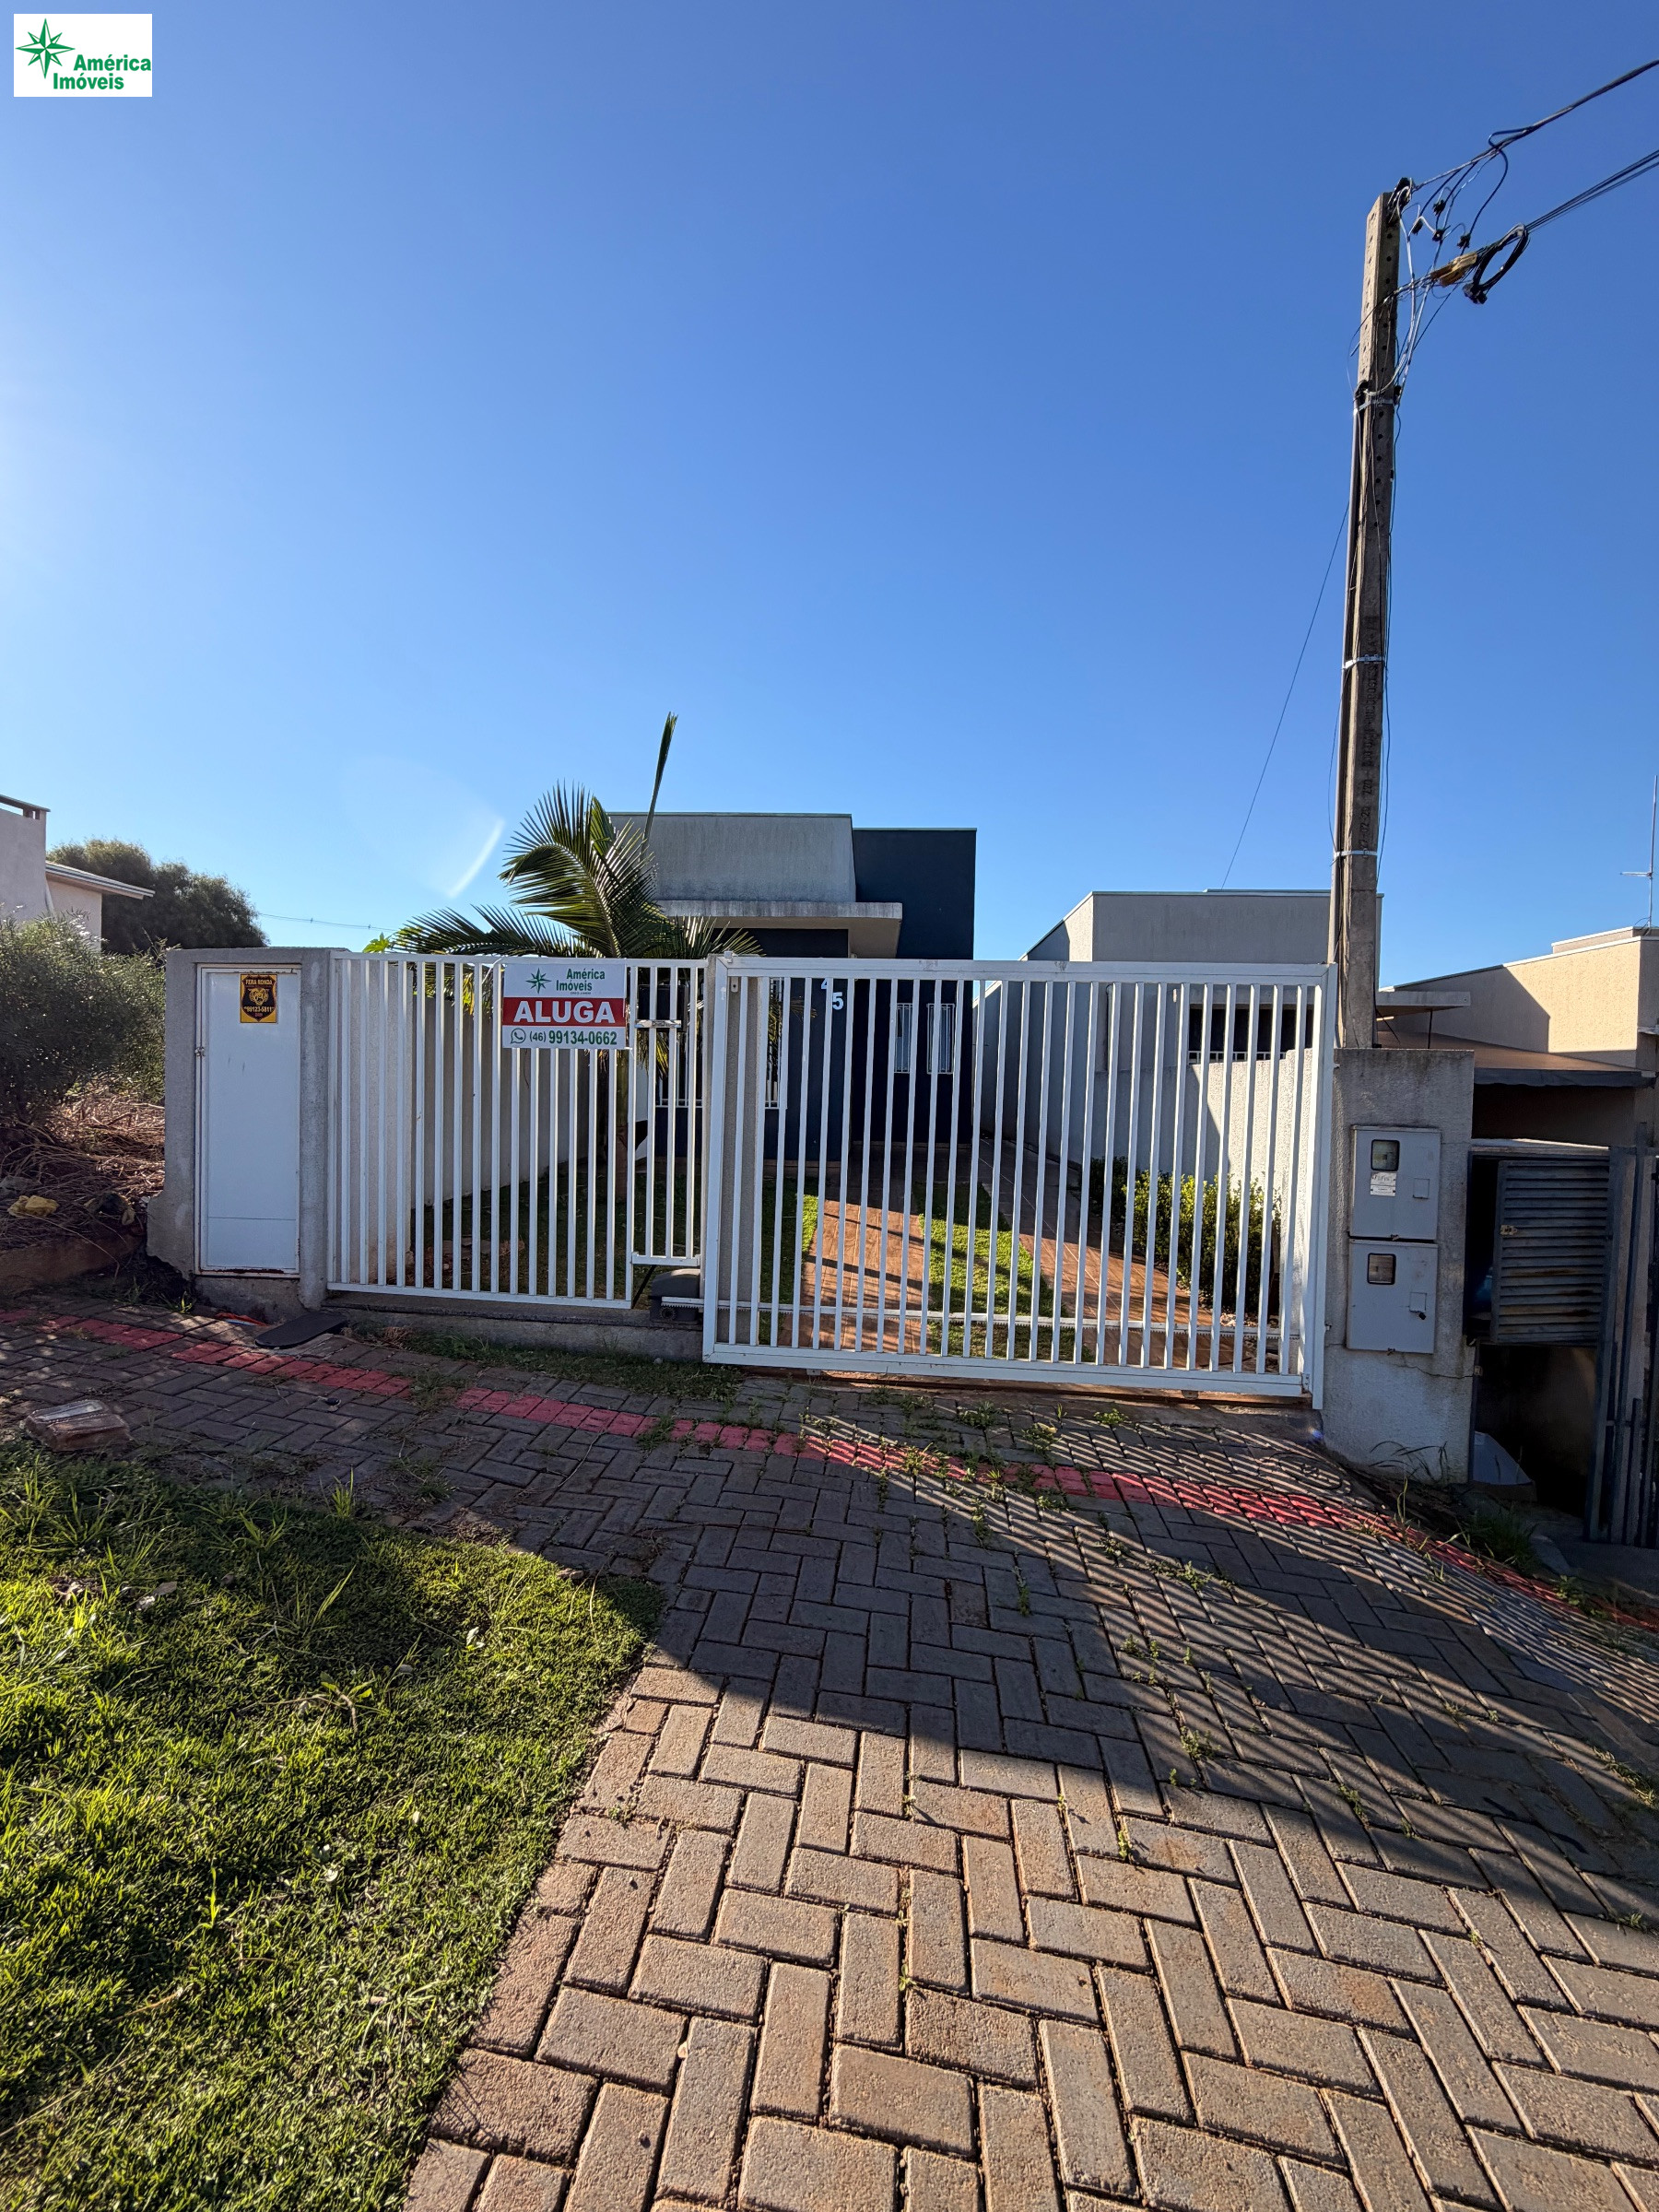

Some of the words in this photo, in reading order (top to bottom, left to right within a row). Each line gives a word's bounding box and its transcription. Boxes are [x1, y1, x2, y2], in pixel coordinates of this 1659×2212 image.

[566, 968, 606, 980] América
[556, 980, 593, 992] Imóveis
[513, 1000, 616, 1024] ALUGA
[529, 1031, 547, 1042] (46)
[548, 1030, 618, 1045] 99134-0662
